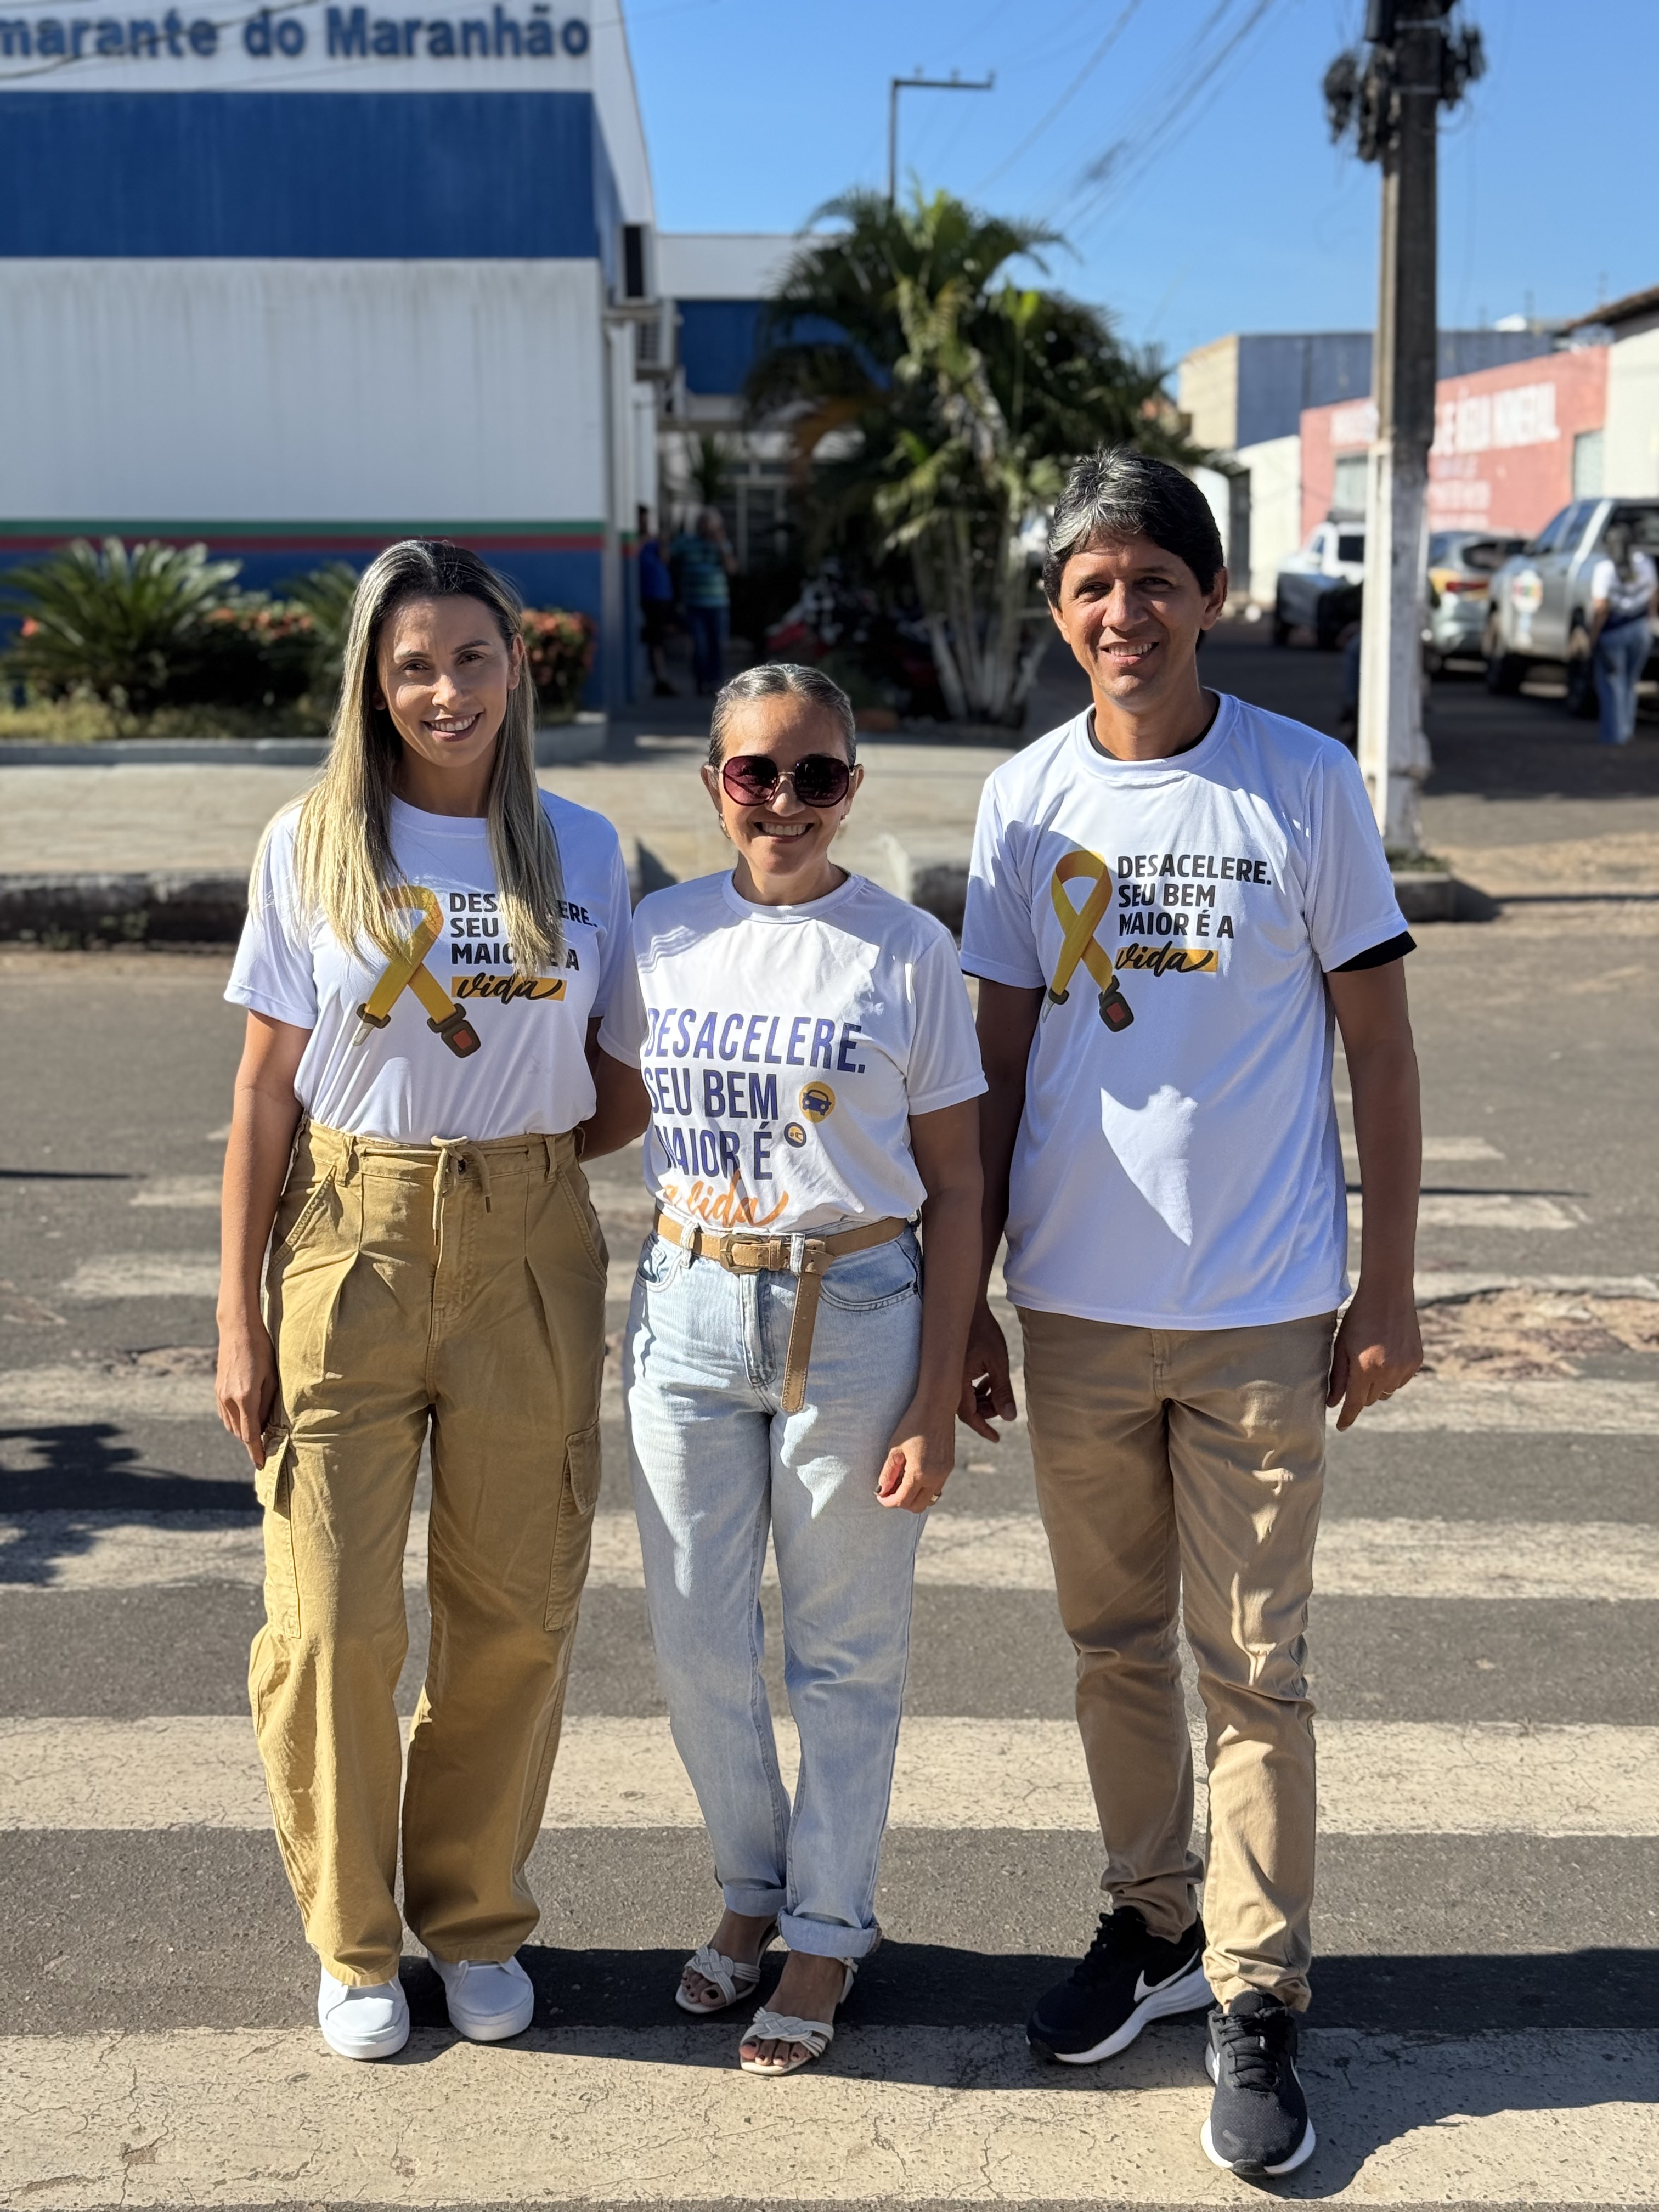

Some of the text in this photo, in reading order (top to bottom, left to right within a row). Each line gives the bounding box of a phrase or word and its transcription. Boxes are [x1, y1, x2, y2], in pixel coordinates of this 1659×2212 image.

[243, 6, 307, 58] do
[325, 4, 590, 59] Maranhão
[1118, 854, 1272, 885] DESACELERE.
[1118, 883, 1215, 908] SEU BEM
[450, 917, 499, 938] SEU
[1119, 909, 1234, 939] MAIOR É A
[644, 1008, 865, 1074] DESACELERE.
[644, 1066, 778, 1120] SEU BEM
[753, 1121, 773, 1180] É
